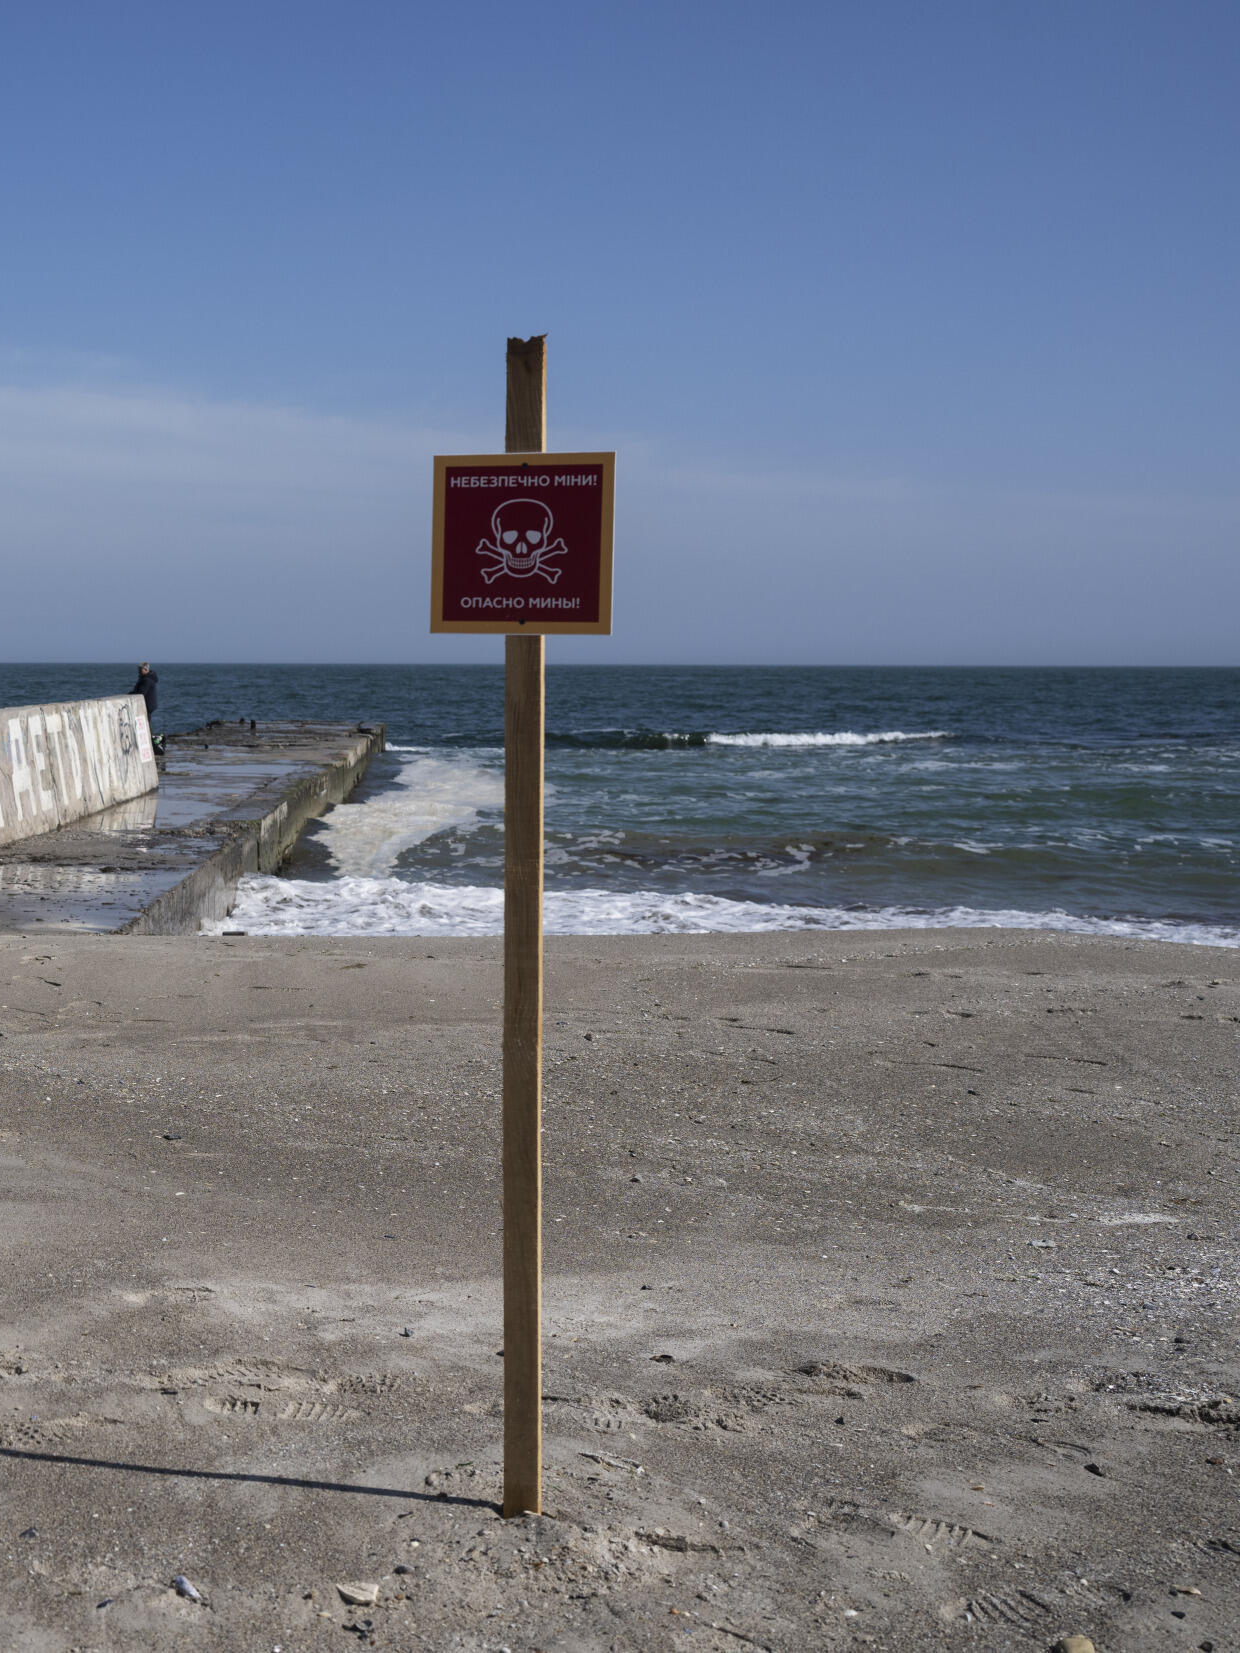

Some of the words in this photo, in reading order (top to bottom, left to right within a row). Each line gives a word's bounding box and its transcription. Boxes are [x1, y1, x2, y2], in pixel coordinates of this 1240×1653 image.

[450, 476, 550, 488] НЕБЕЗПЕЧНО
[554, 474, 598, 487] МІНИ!
[460, 597, 525, 609] ОПАСНО
[528, 597, 580, 609] МИНЫ!
